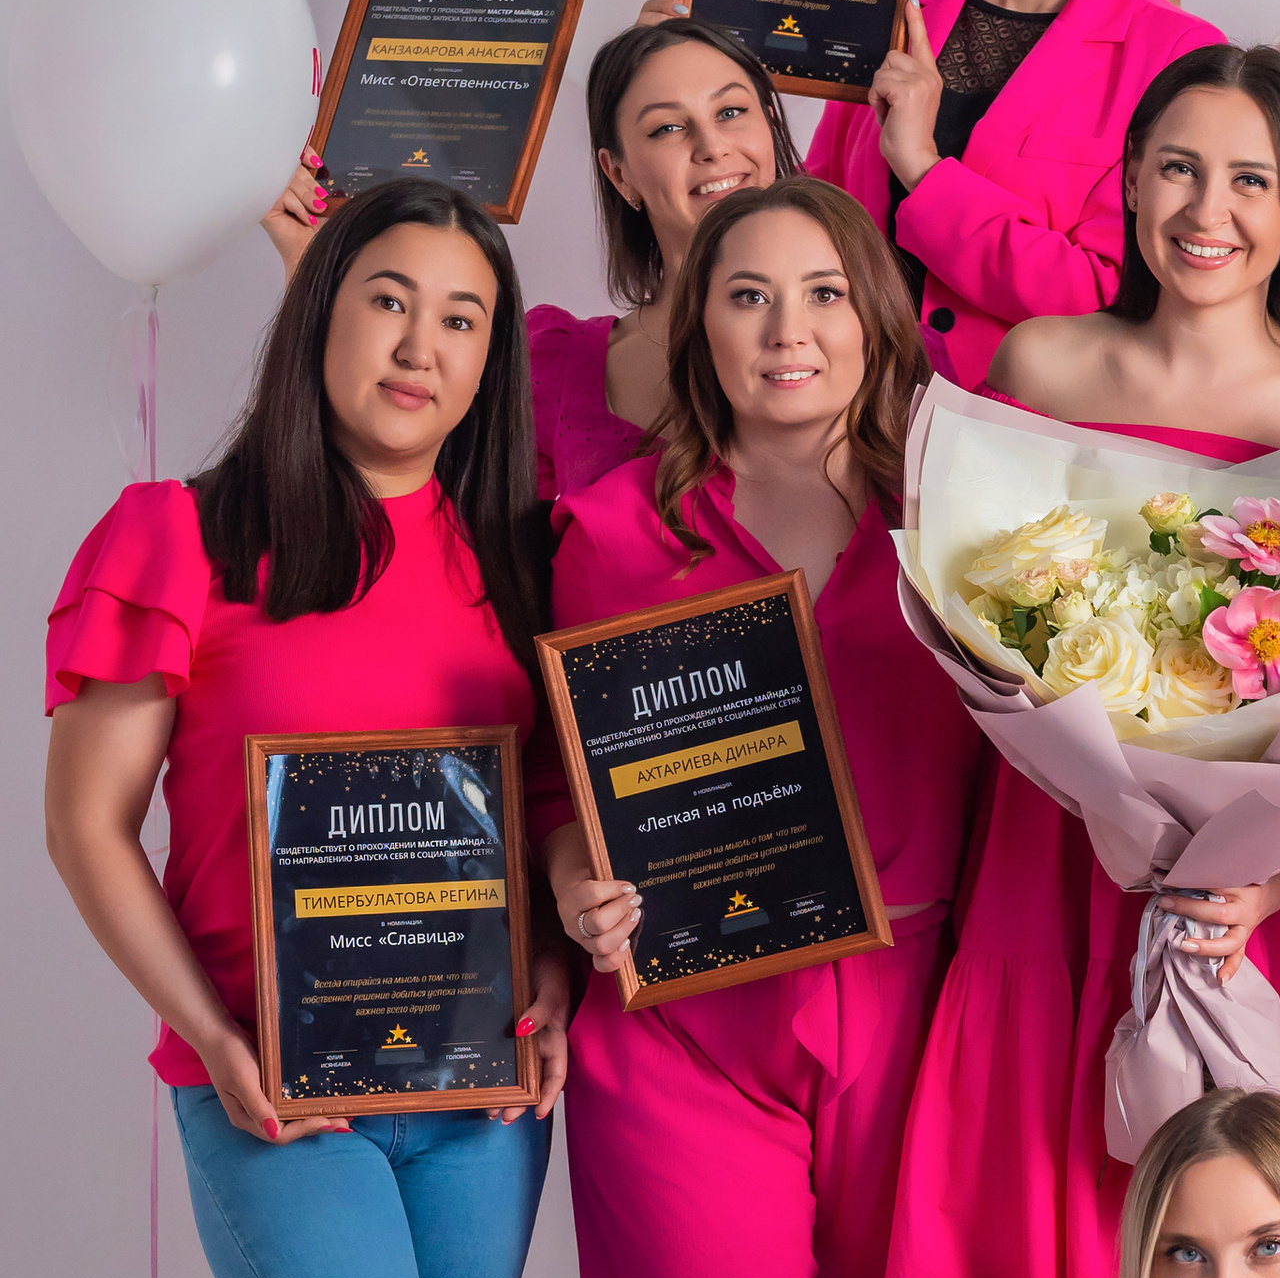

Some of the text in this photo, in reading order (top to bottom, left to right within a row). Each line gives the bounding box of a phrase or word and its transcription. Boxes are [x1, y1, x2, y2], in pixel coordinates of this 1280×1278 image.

[371, 44, 543, 59] КАНЗАФАРОВА АНАСТАСИЯ
[360, 73, 529, 89] Мисс «Ответственность»
[631, 660, 746, 720] ДИПЛОМ
[586, 722, 654, 746] СВИДЕТЕЛЬСТВУЕТ
[663, 705, 722, 726] ПРОХОЖДЕНИИ
[723, 697, 753, 711] МАСТЕР
[754, 688, 790, 703] МАЙНДА
[790, 684, 802, 693] 2.0
[590, 747, 603, 756] ПО
[603, 732, 662, 753] НАПРАВЛЕНИЮ
[662, 723, 697, 738] ЗАПУСКА
[697, 718, 716, 728] СЕБЯ
[724, 702, 777, 721] СОЦИАЛЬНЫХ
[778, 696, 801, 707] СЕТЯХ
[637, 734, 787, 783] АХТАРИЕВА ДИНАРА
[328, 801, 445, 838] ДИПЛОМ
[638, 783, 801, 832] «Легкая на подъём»
[275, 844, 347, 855] СВИДЕТЕЛЬСТВУЕТ
[356, 841, 416, 850] ПРОХОЖДЕНИИ
[417, 839, 448, 847] МАСТЕР
[449, 837, 485, 846] МАЙНДА
[292, 854, 352, 864] НАПРАВЛЕНИЮ
[354, 853, 388, 862] ЗАПУСКА
[389, 852, 408, 860] СЕБЯ
[416, 849, 470, 859] СОЦИАЛЬНЫХ
[471, 848, 494, 856] СЕТЯХ
[301, 887, 499, 909] ТИМЕРБУЛАТОВА РЕГИНА
[330, 931, 464, 948] Мисс «Славица»
